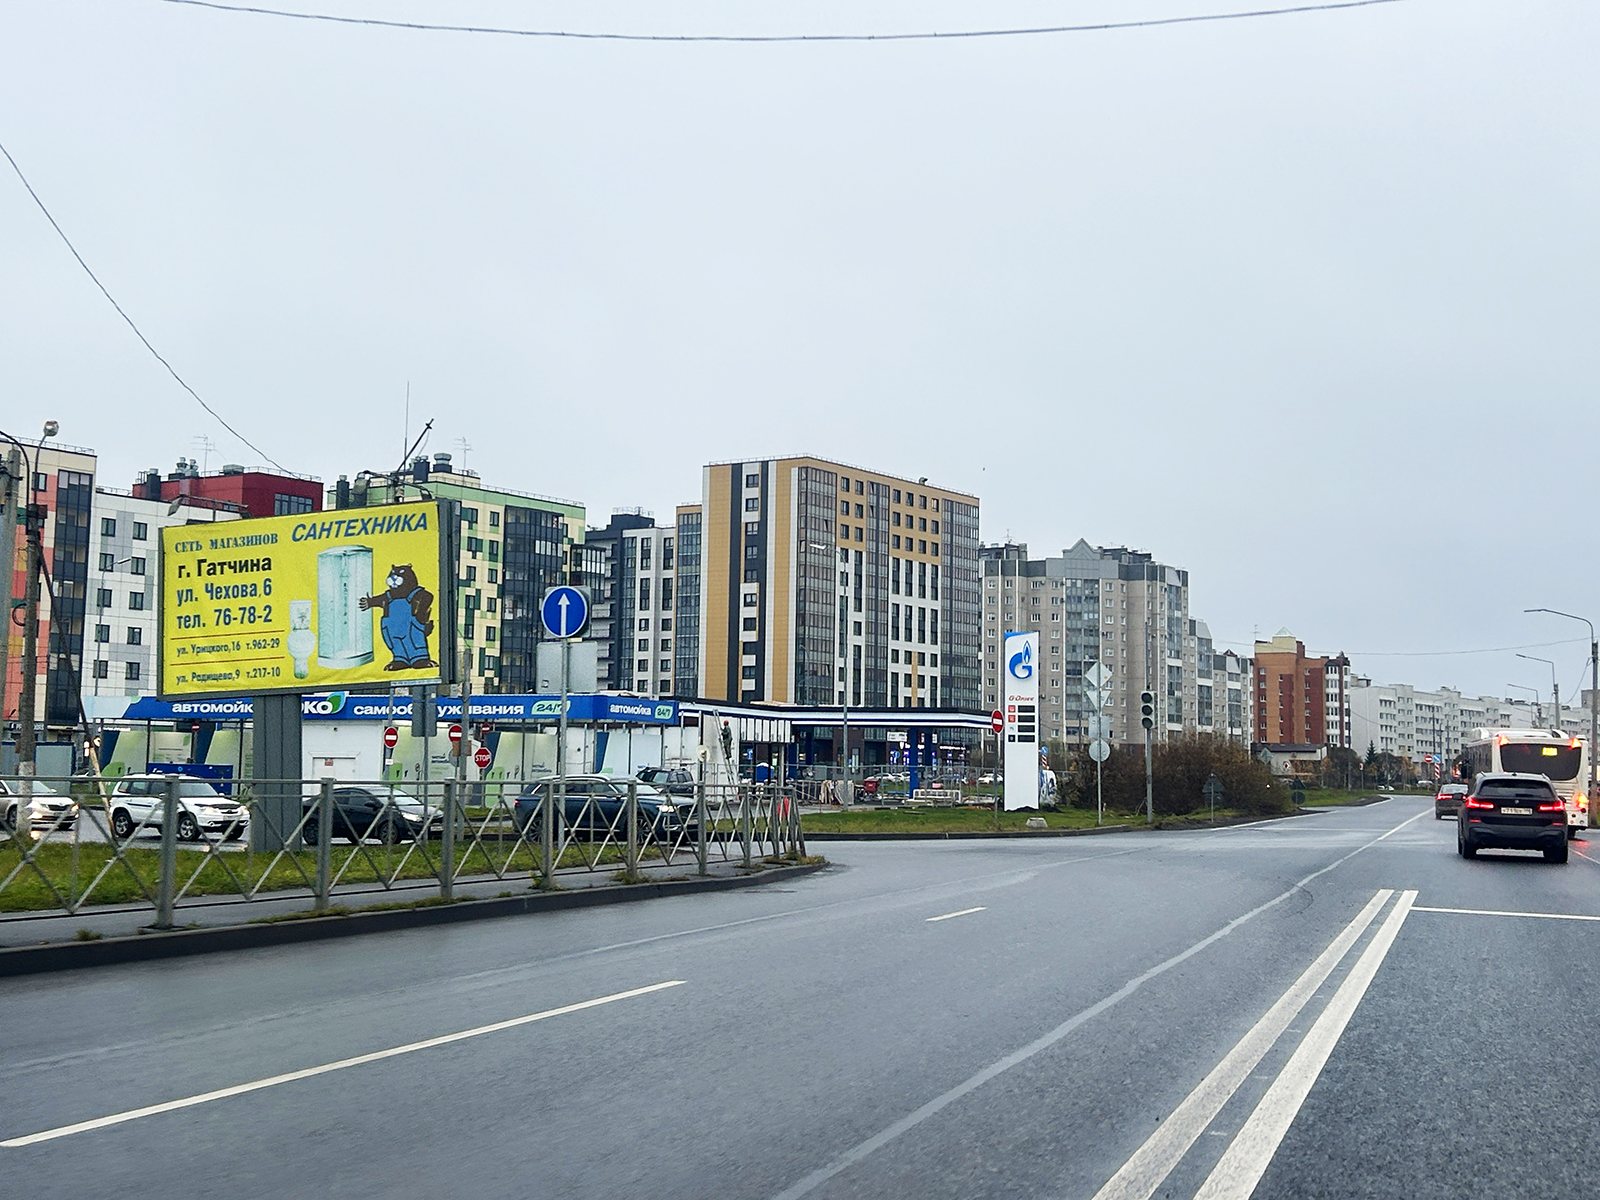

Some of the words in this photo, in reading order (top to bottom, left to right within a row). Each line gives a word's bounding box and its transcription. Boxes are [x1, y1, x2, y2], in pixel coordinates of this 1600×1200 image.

[291, 513, 428, 542] САНТЕХНИКА
[175, 541, 203, 553] СЕТЬ
[209, 533, 278, 549] МАГАЗИНОВ
[178, 565, 191, 578] г.
[197, 557, 272, 577] Гатчина
[176, 588, 198, 607] ул.
[176, 613, 206, 629] тел.
[214, 604, 273, 626] 76-78-2
[176, 647, 188, 657] ул.
[176, 675, 188, 685] ул.
[171, 702, 254, 714] автомойк
[300, 700, 333, 715] КО
[609, 704, 652, 715] автомойка
[475, 754, 490, 762] STOP
